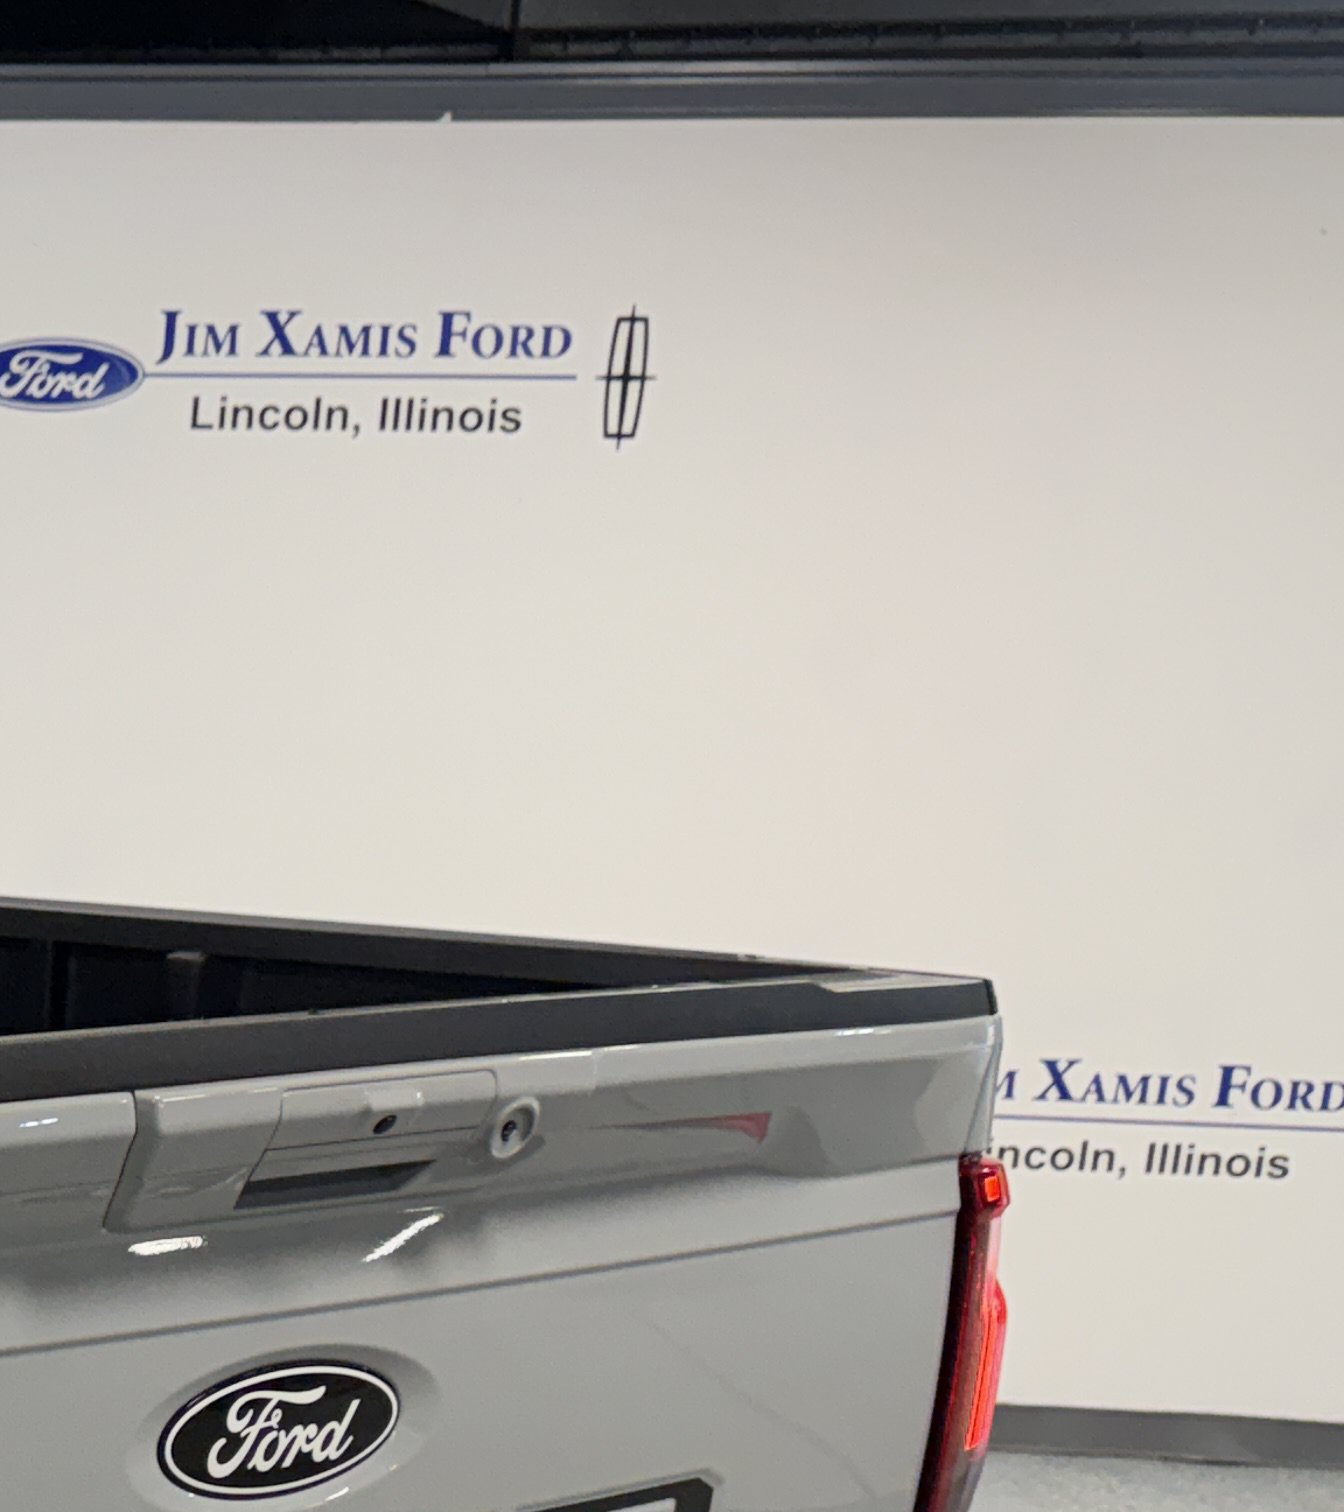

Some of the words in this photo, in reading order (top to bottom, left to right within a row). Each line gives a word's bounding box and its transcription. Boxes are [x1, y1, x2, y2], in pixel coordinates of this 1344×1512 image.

[156, 310, 240, 365] JIM
[256, 310, 418, 358] XAMIS
[434, 310, 572, 359] FORD
[190, 396, 361, 438] Lincoln,
[379, 397, 522, 433] Illinois
[1034, 1058, 1197, 1107] XAMIS
[1144, 1142, 1290, 1179] Illinois
[207, 1386, 360, 1478] Ford
